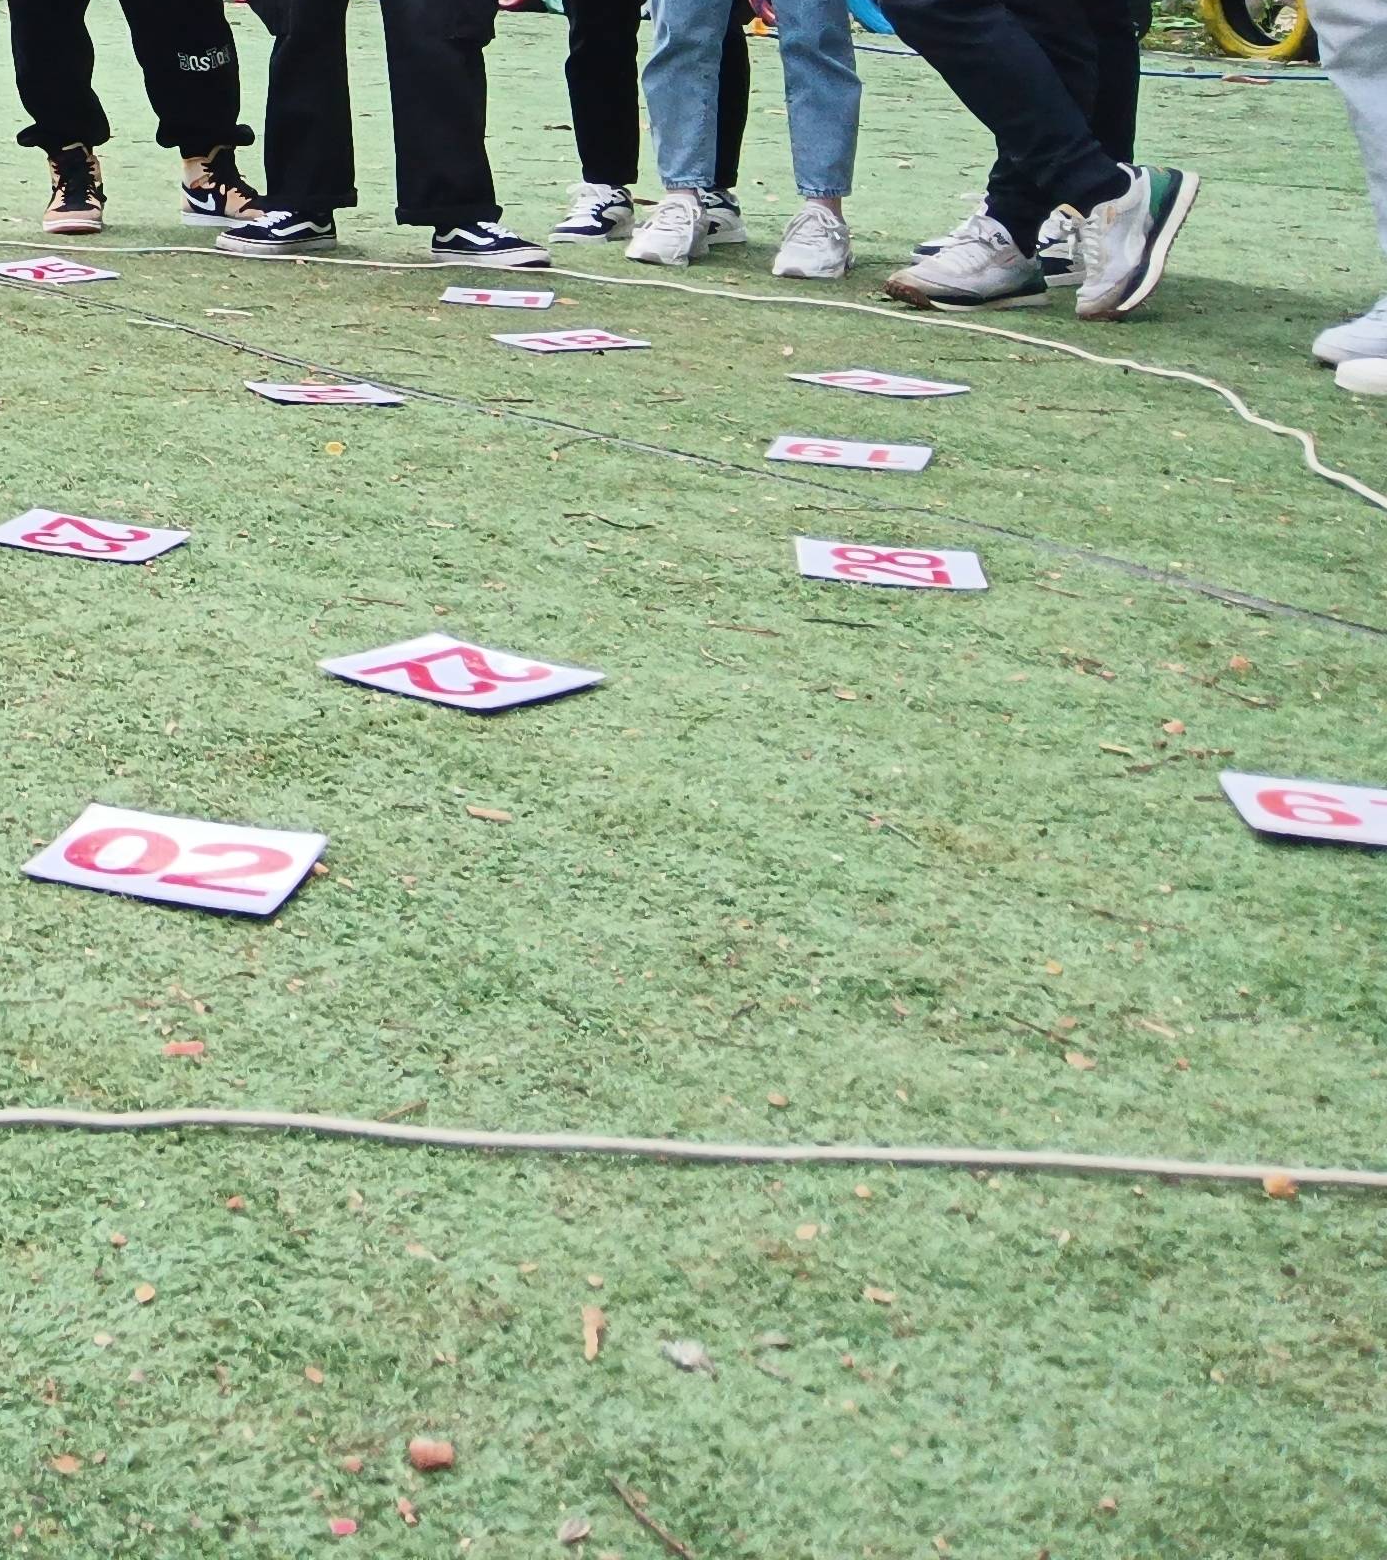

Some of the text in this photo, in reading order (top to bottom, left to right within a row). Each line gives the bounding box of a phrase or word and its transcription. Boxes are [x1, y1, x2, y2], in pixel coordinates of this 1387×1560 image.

[8, 264, 95, 281] 25
[521, 334, 627, 348] 18
[785, 442, 904, 465] 19
[20, 516, 151, 553] 23
[831, 546, 952, 586] 28
[359, 646, 551, 696] 22
[63, 828, 293, 897] 02
